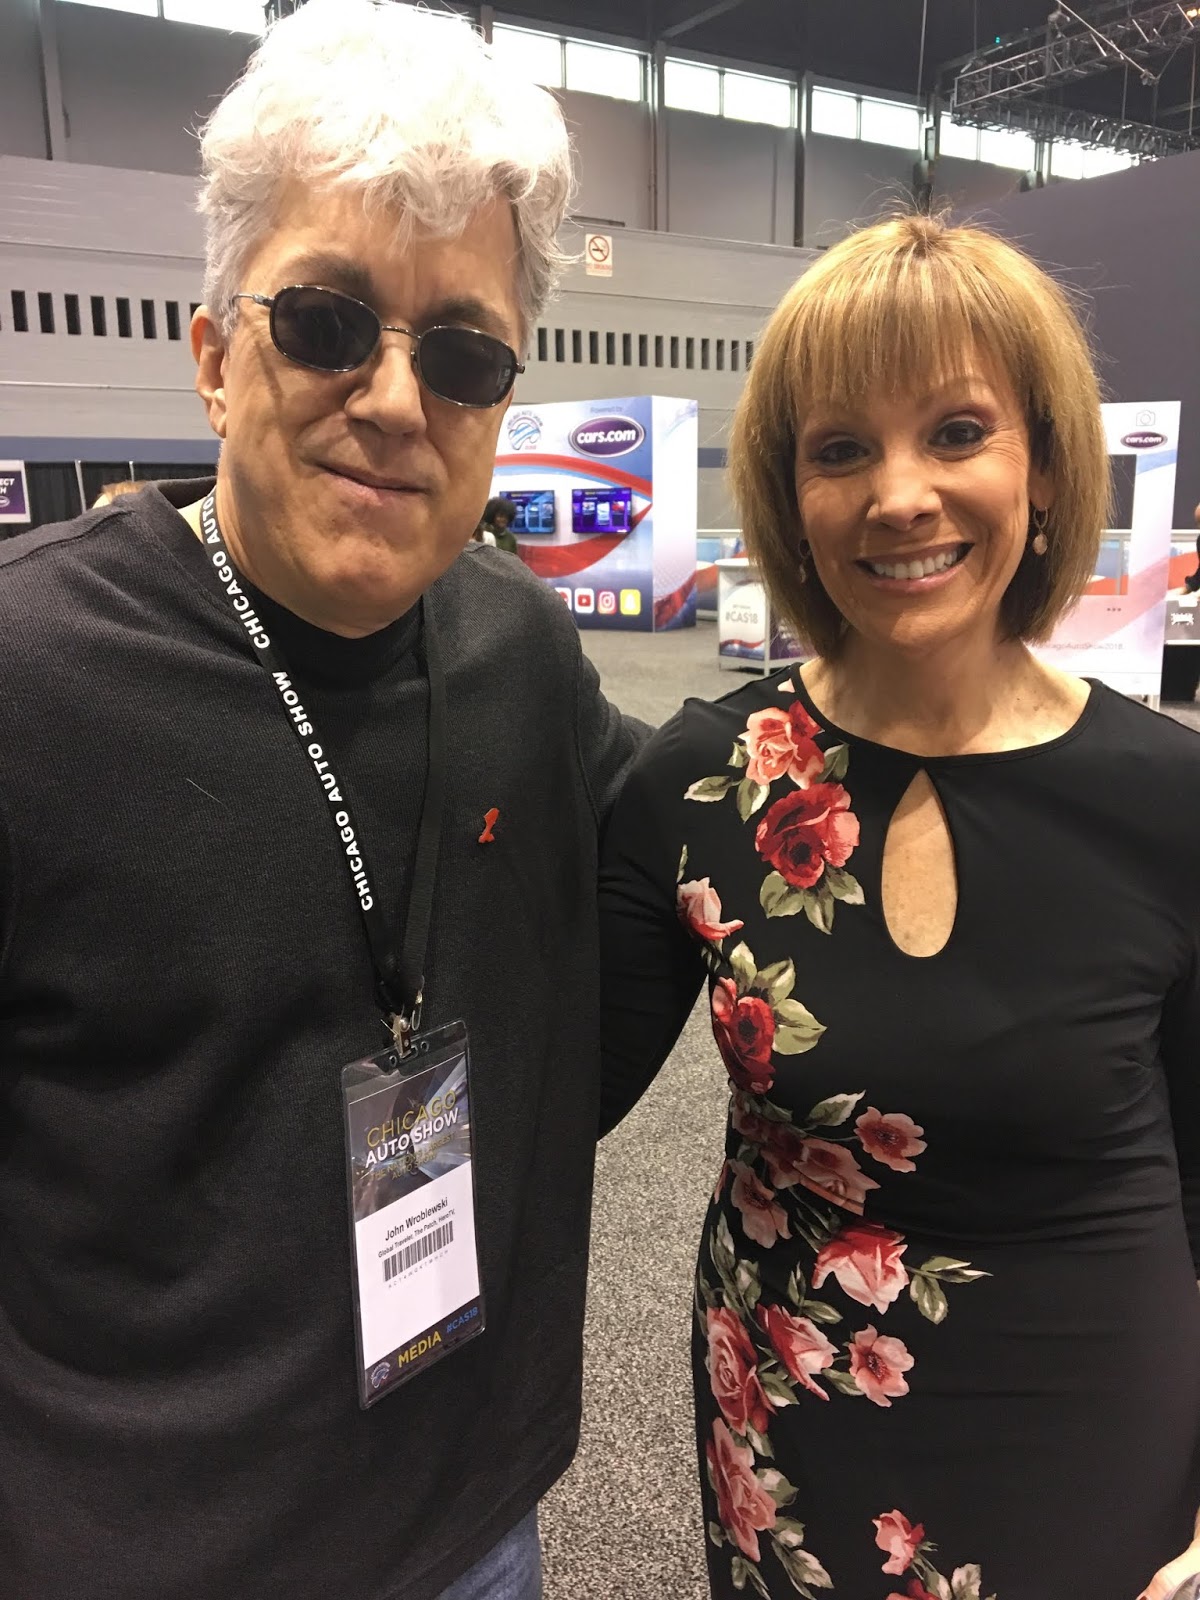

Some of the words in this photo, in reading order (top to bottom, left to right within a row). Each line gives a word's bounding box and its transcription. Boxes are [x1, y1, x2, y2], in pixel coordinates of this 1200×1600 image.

[577, 429, 637, 444] cars.com
[1125, 436, 1162, 444] cars.com
[202, 496, 221, 544] AUTO
[212, 550, 271, 649] CHICAGO
[725, 611, 758, 624] #CAS18
[272, 671, 314, 737] SHOW
[308, 743, 343, 802] AUTO
[335, 810, 373, 911] CHICAGO
[365, 1135, 409, 1168] AUTO
[414, 1108, 459, 1144] SHOW
[367, 1090, 456, 1147] CHICAGO
[378, 1244, 394, 1258] Global
[414, 1228, 423, 1236] The
[385, 1224, 404, 1241] John
[405, 1197, 448, 1229] Wroblewski
[397, 1331, 442, 1368] MEDIA
[446, 1307, 478, 1333] #CAS18
